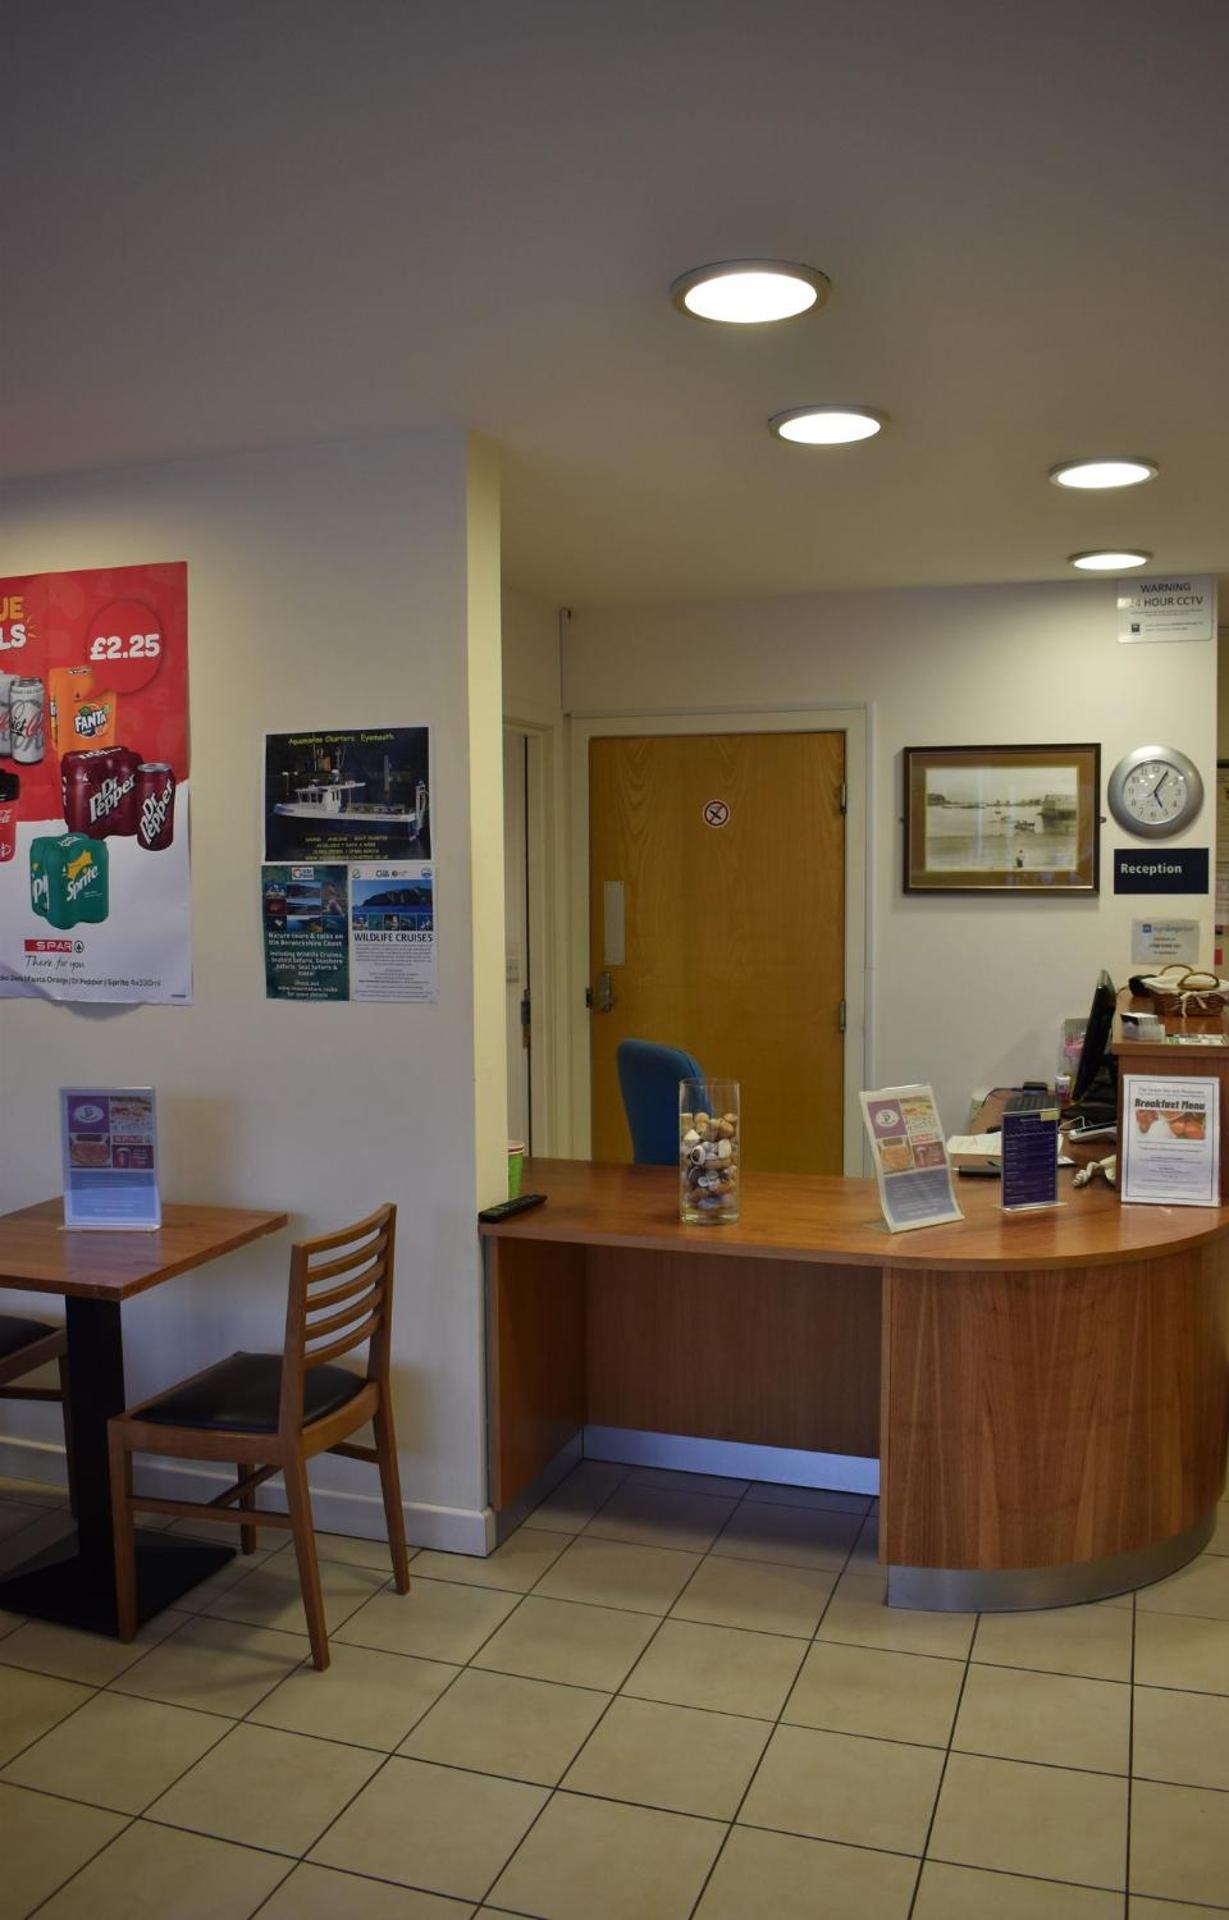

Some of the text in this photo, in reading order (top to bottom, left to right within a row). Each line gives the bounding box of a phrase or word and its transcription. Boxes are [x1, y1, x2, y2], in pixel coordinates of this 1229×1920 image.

[1140, 582, 1191, 593] WARNING
[1144, 598, 1174, 607] HOUR
[1177, 596, 1203, 606] CCTV
[90, 633, 161, 661] £2.25
[75, 711, 107, 732] FANTA
[101, 776, 118, 797] Dr
[89, 774, 136, 823] Pepper
[142, 792, 157, 818] Dr
[139, 779, 174, 845] Pepper
[1120, 863, 1183, 876] Reception
[66, 865, 100, 902] Sprite
[36, 941, 72, 951] SPAR
[354, 933, 433, 943] WILDLIFE CRUISES
[25, 955, 85, 973] There for you
[1135, 1098, 1206, 1110] Breakfast Menu
